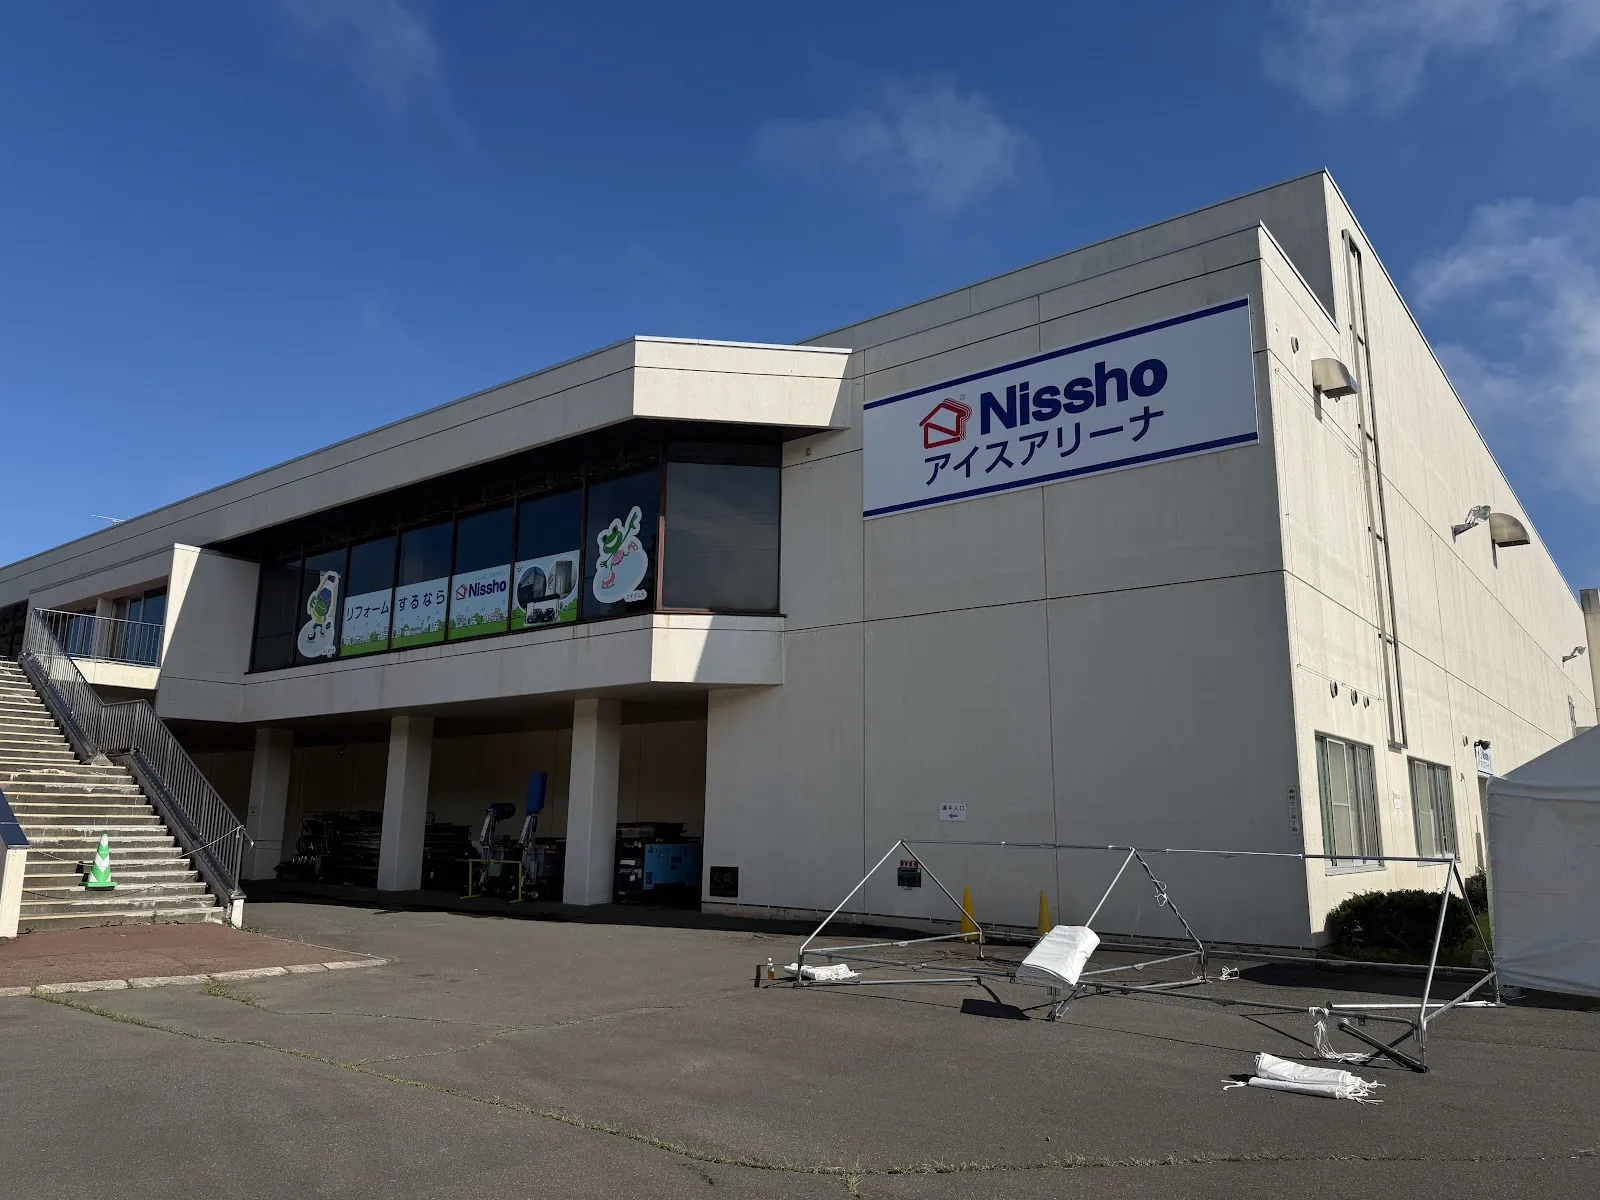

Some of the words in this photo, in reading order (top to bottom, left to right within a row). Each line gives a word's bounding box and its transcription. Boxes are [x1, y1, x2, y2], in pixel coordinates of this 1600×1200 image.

[980, 358, 1168, 436] Nissho
[924, 405, 1165, 486] アイスアリーナ
[346, 602, 391, 622] リフォーム
[398, 588, 446, 612] するなら
[468, 579, 507, 599] Nissho
